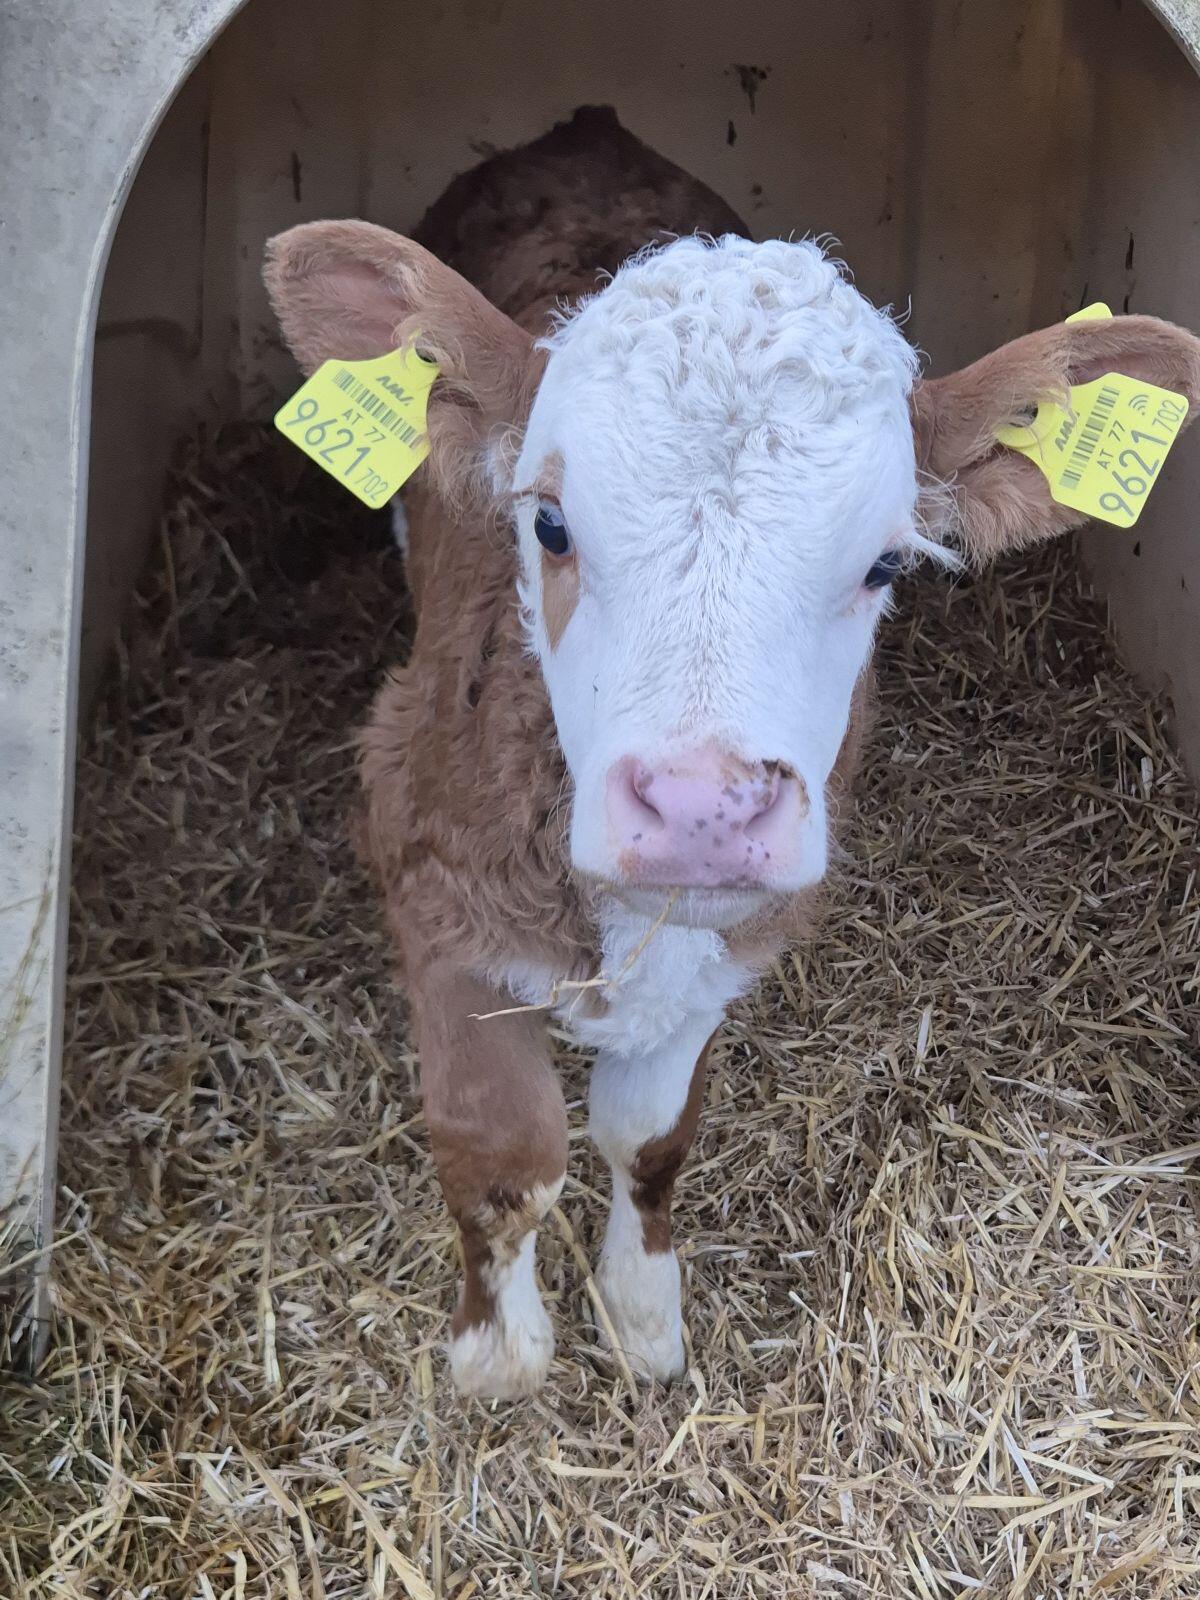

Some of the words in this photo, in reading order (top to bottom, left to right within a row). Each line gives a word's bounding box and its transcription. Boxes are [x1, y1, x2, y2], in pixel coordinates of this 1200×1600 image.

[286, 398, 371, 476] 9621
[354, 467, 388, 501] 702
[341, 409, 363, 426] AT
[364, 426, 386, 443] 77
[1096, 448, 1114, 470] AT
[1108, 420, 1126, 442] 77
[1099, 429, 1168, 518] 9621
[1151, 399, 1185, 433] 702
